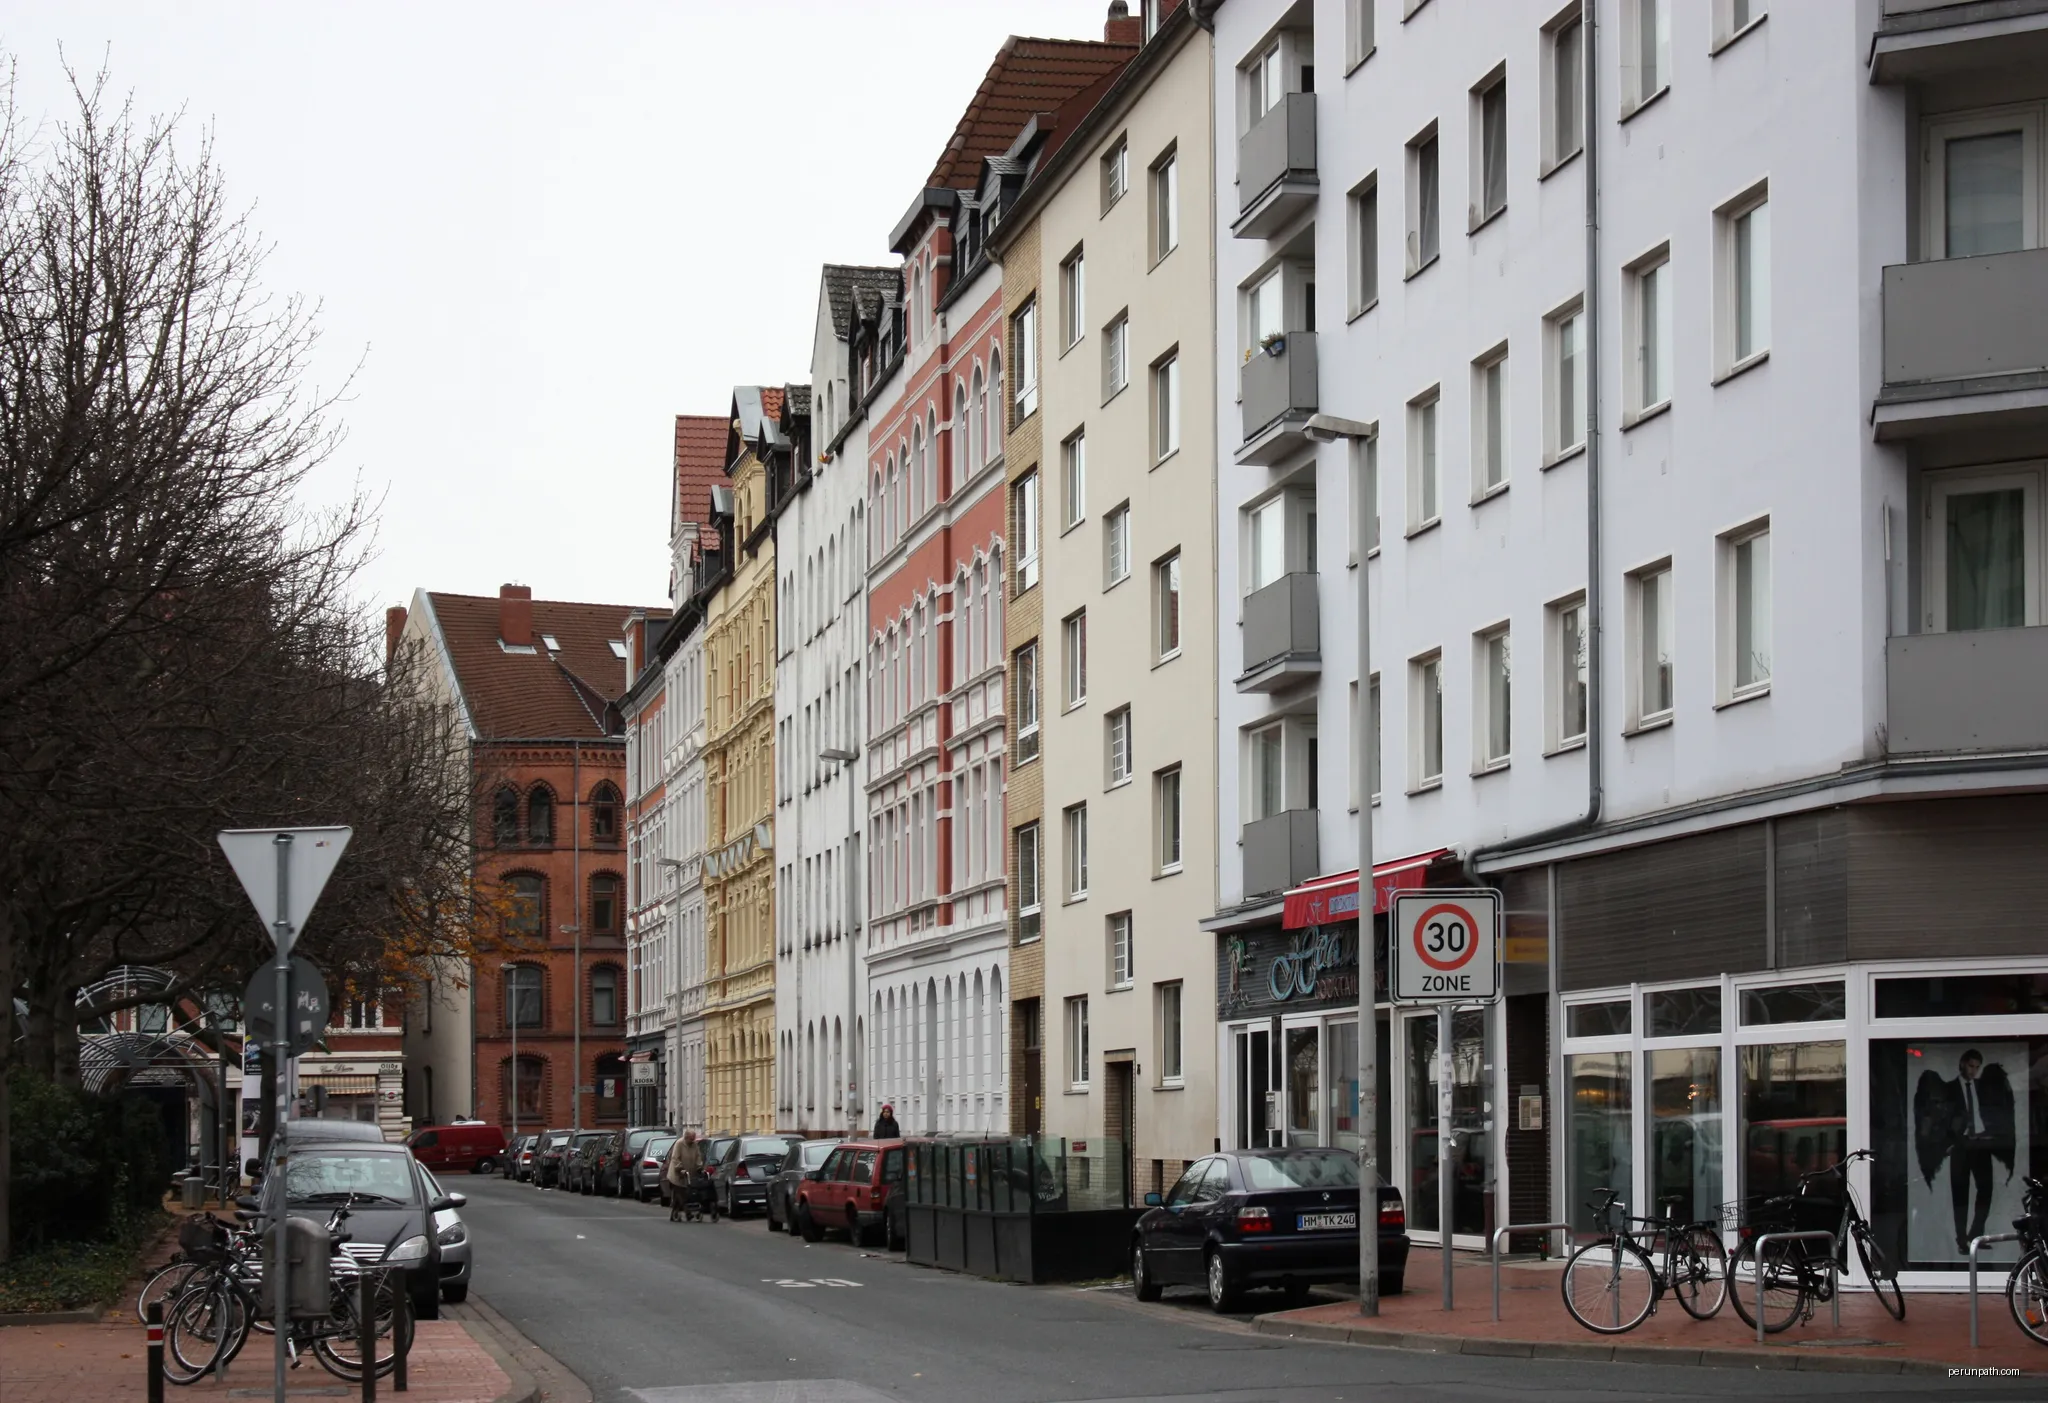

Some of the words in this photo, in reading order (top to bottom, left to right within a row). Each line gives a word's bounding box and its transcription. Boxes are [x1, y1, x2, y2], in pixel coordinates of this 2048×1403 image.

[1427, 922, 1465, 952] 30
[1422, 975, 1471, 991] ZONE
[1303, 1216, 1317, 1227] HM
[1323, 1215, 1336, 1226] TK
[1337, 1214, 1355, 1225] 240
